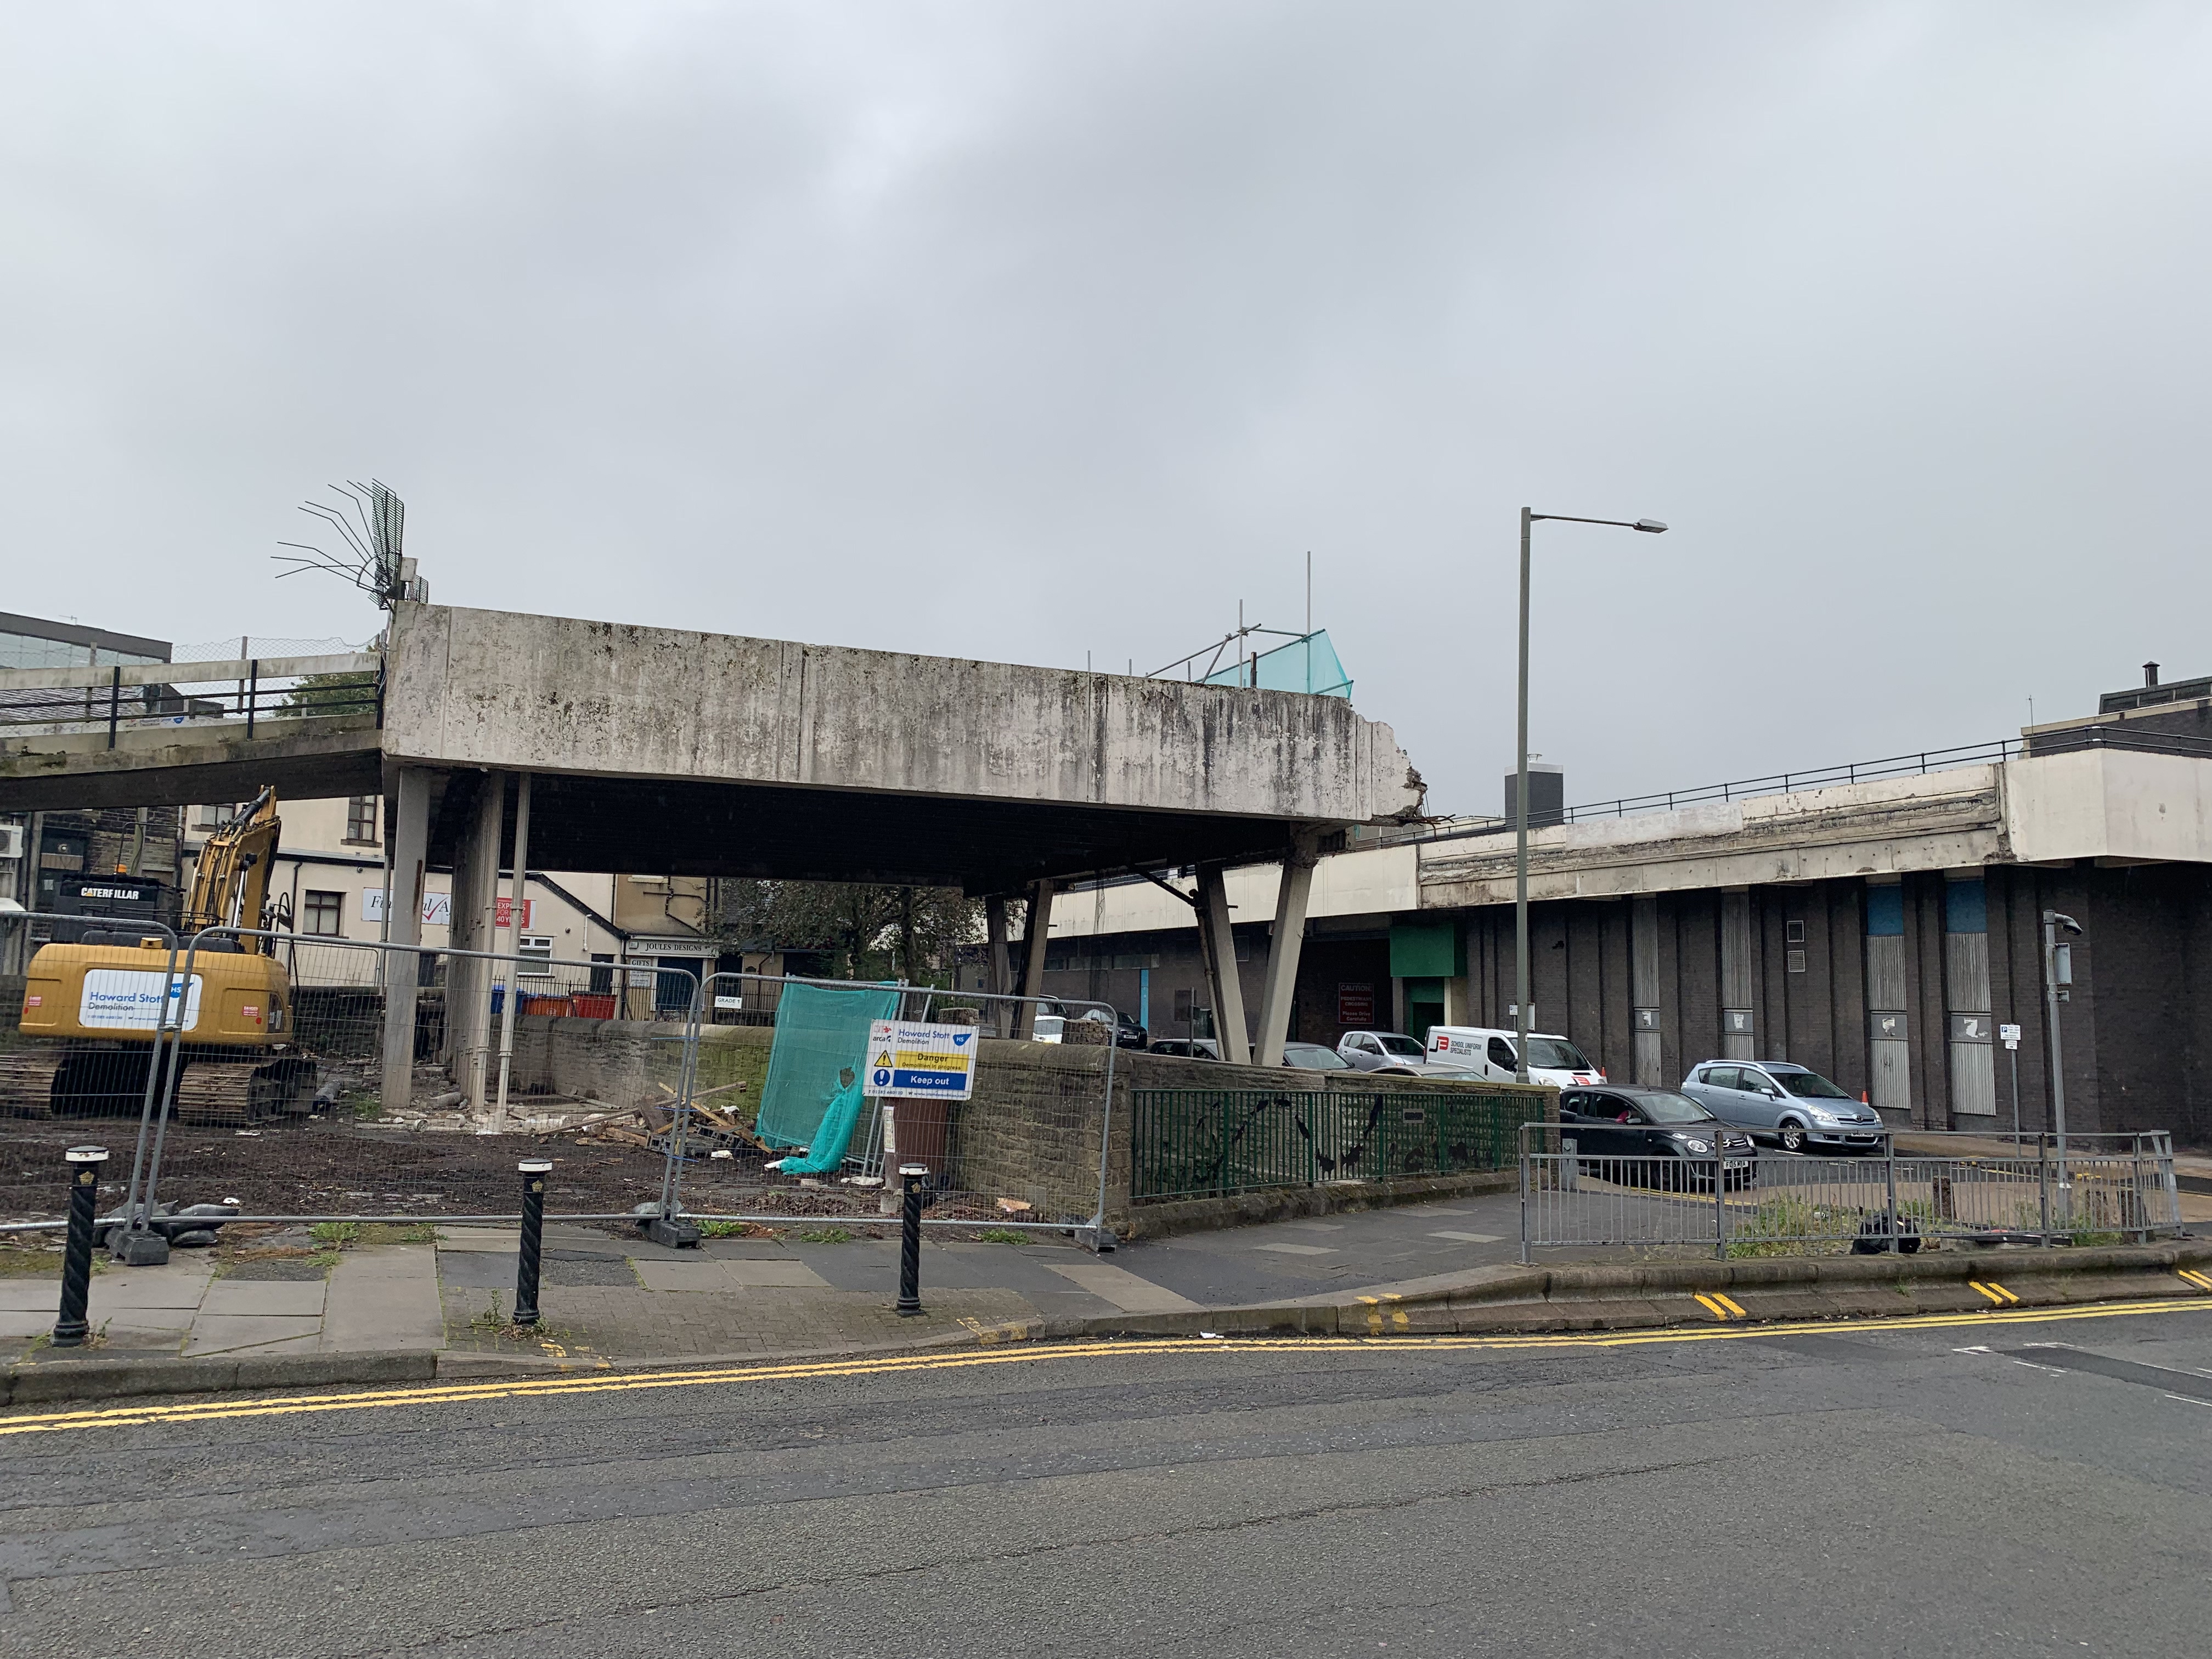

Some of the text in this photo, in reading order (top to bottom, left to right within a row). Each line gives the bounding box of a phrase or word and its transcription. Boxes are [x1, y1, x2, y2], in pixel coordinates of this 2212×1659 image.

[81, 887, 139, 900] CATERPILLAR
[645, 943, 672, 951] JOULES
[90, 991, 136, 1002] Howard
[88, 1002, 133, 1011] Demolition
[899, 1029, 950, 1039] Howard Stott
[1450, 1047, 1471, 1056] SPECIALISTS
[917, 1053, 949, 1063] Danger
[911, 1076, 933, 1085] Keep
